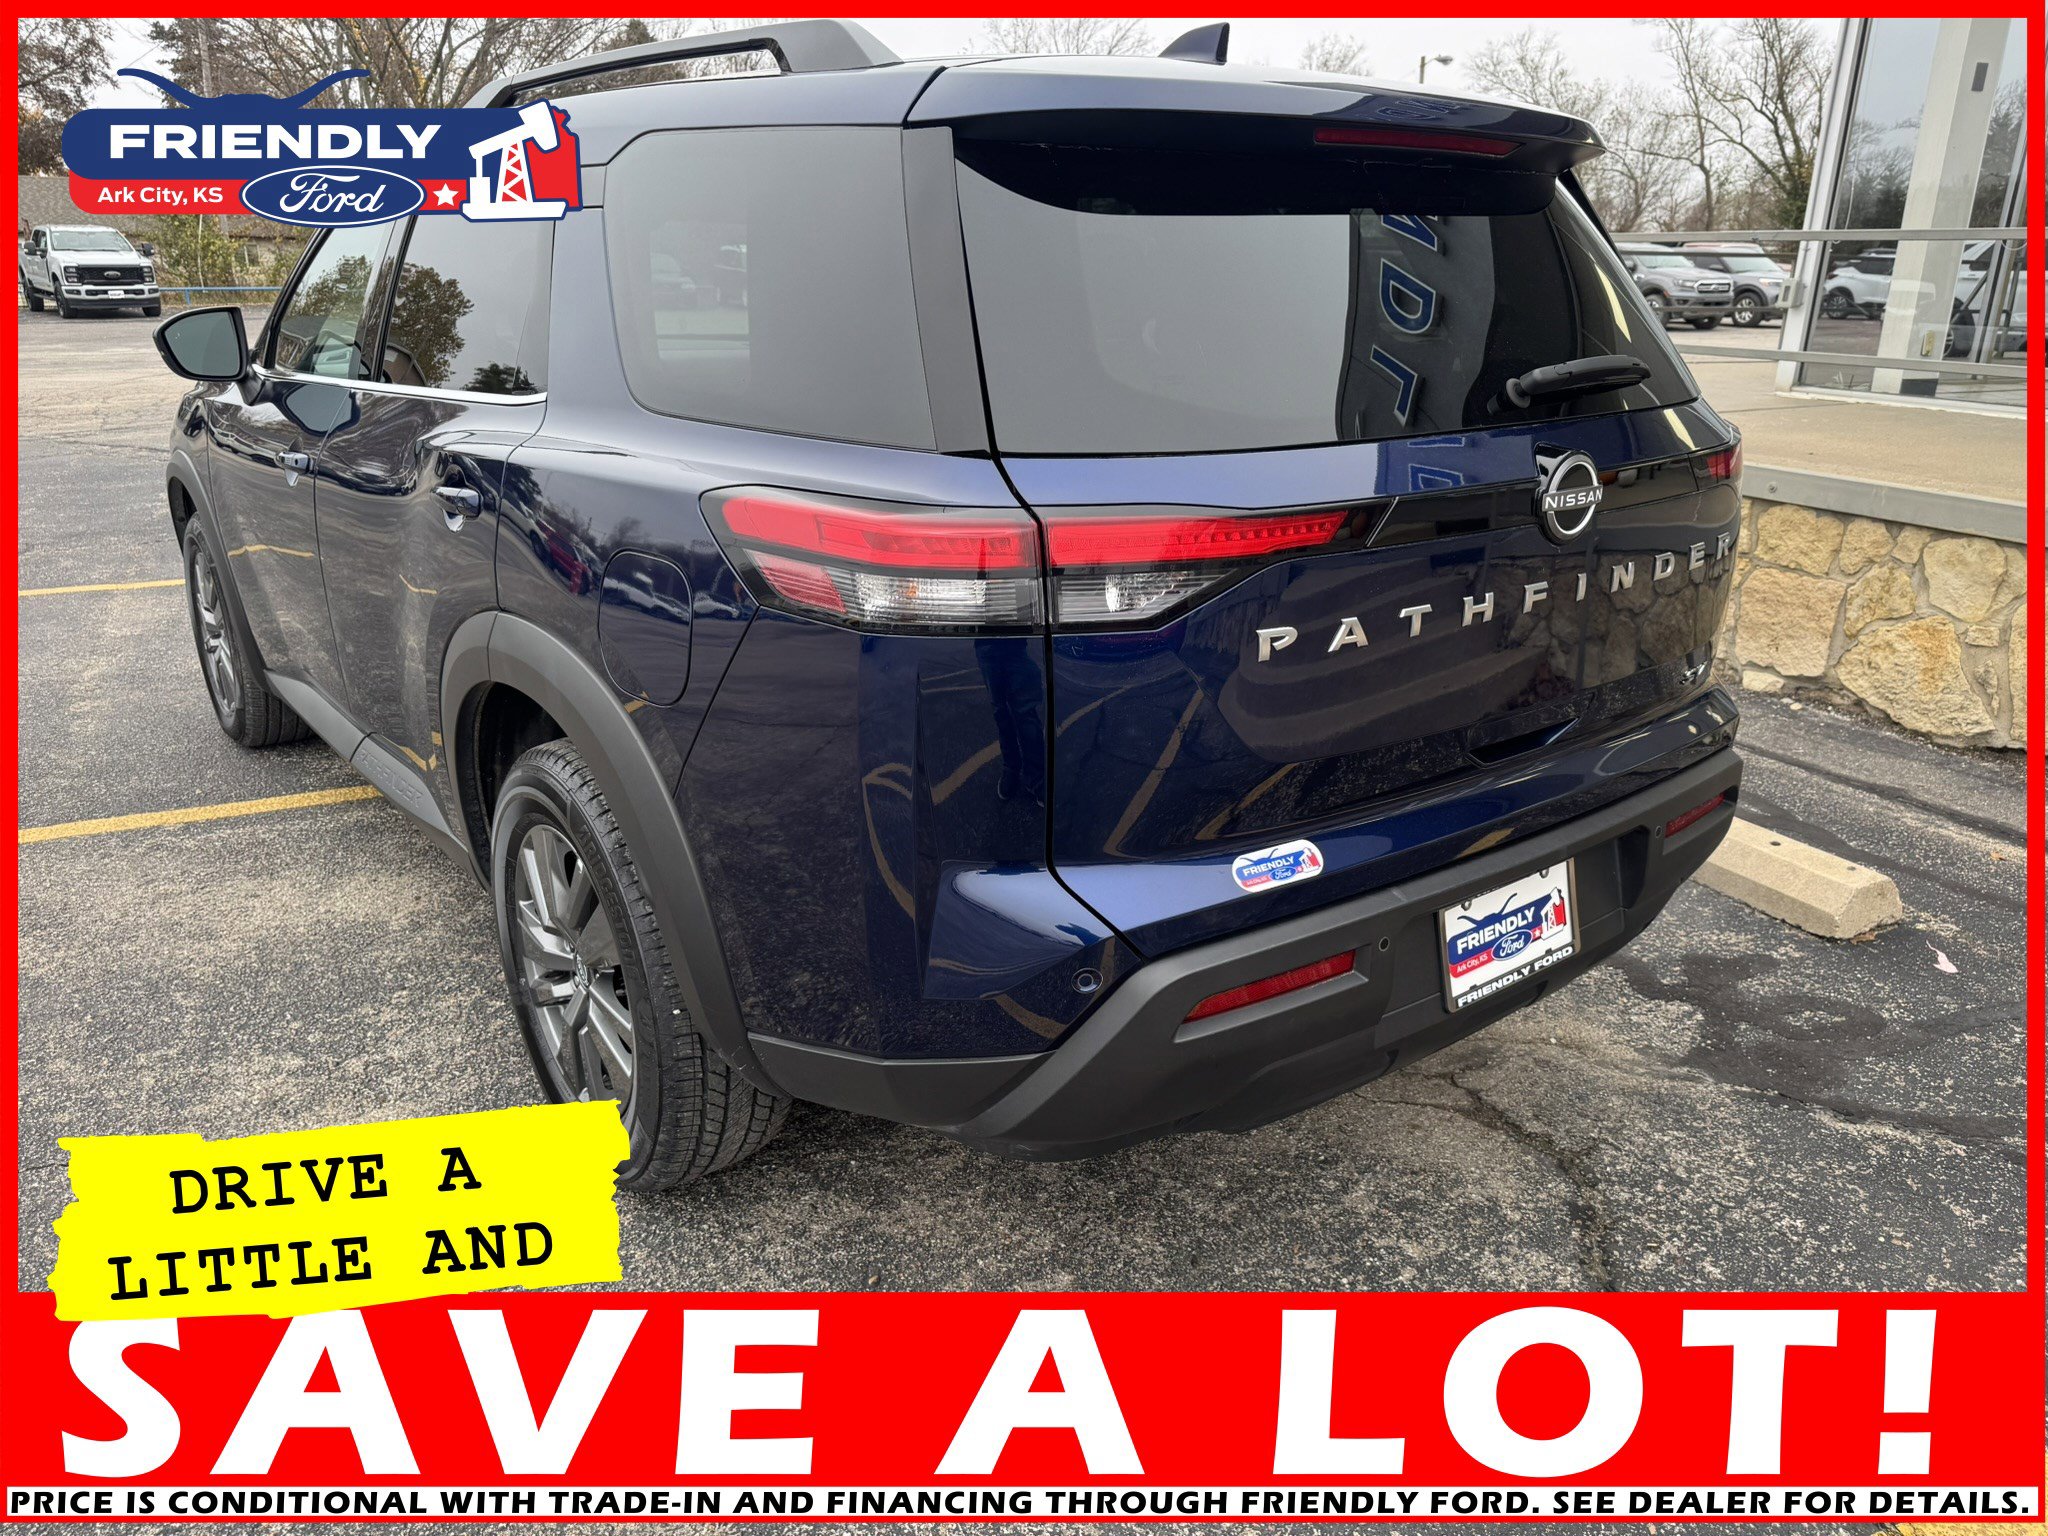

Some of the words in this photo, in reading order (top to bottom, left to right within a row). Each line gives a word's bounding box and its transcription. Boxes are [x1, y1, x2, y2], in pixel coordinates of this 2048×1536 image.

[1545, 488, 1603, 509] NISSAN
[1255, 531, 1733, 662] PATHFINDER
[1242, 856, 1295, 877] FRIENDLY
[1274, 868, 1292, 880] Ford
[1457, 907, 1535, 954] FRIENDLY
[1499, 935, 1525, 957] Ford
[1456, 963, 1466, 973] Ark
[1479, 953, 1488, 963] KS
[1457, 965, 1531, 1008] FRIENDLY
[1534, 946, 1574, 970] FORD
